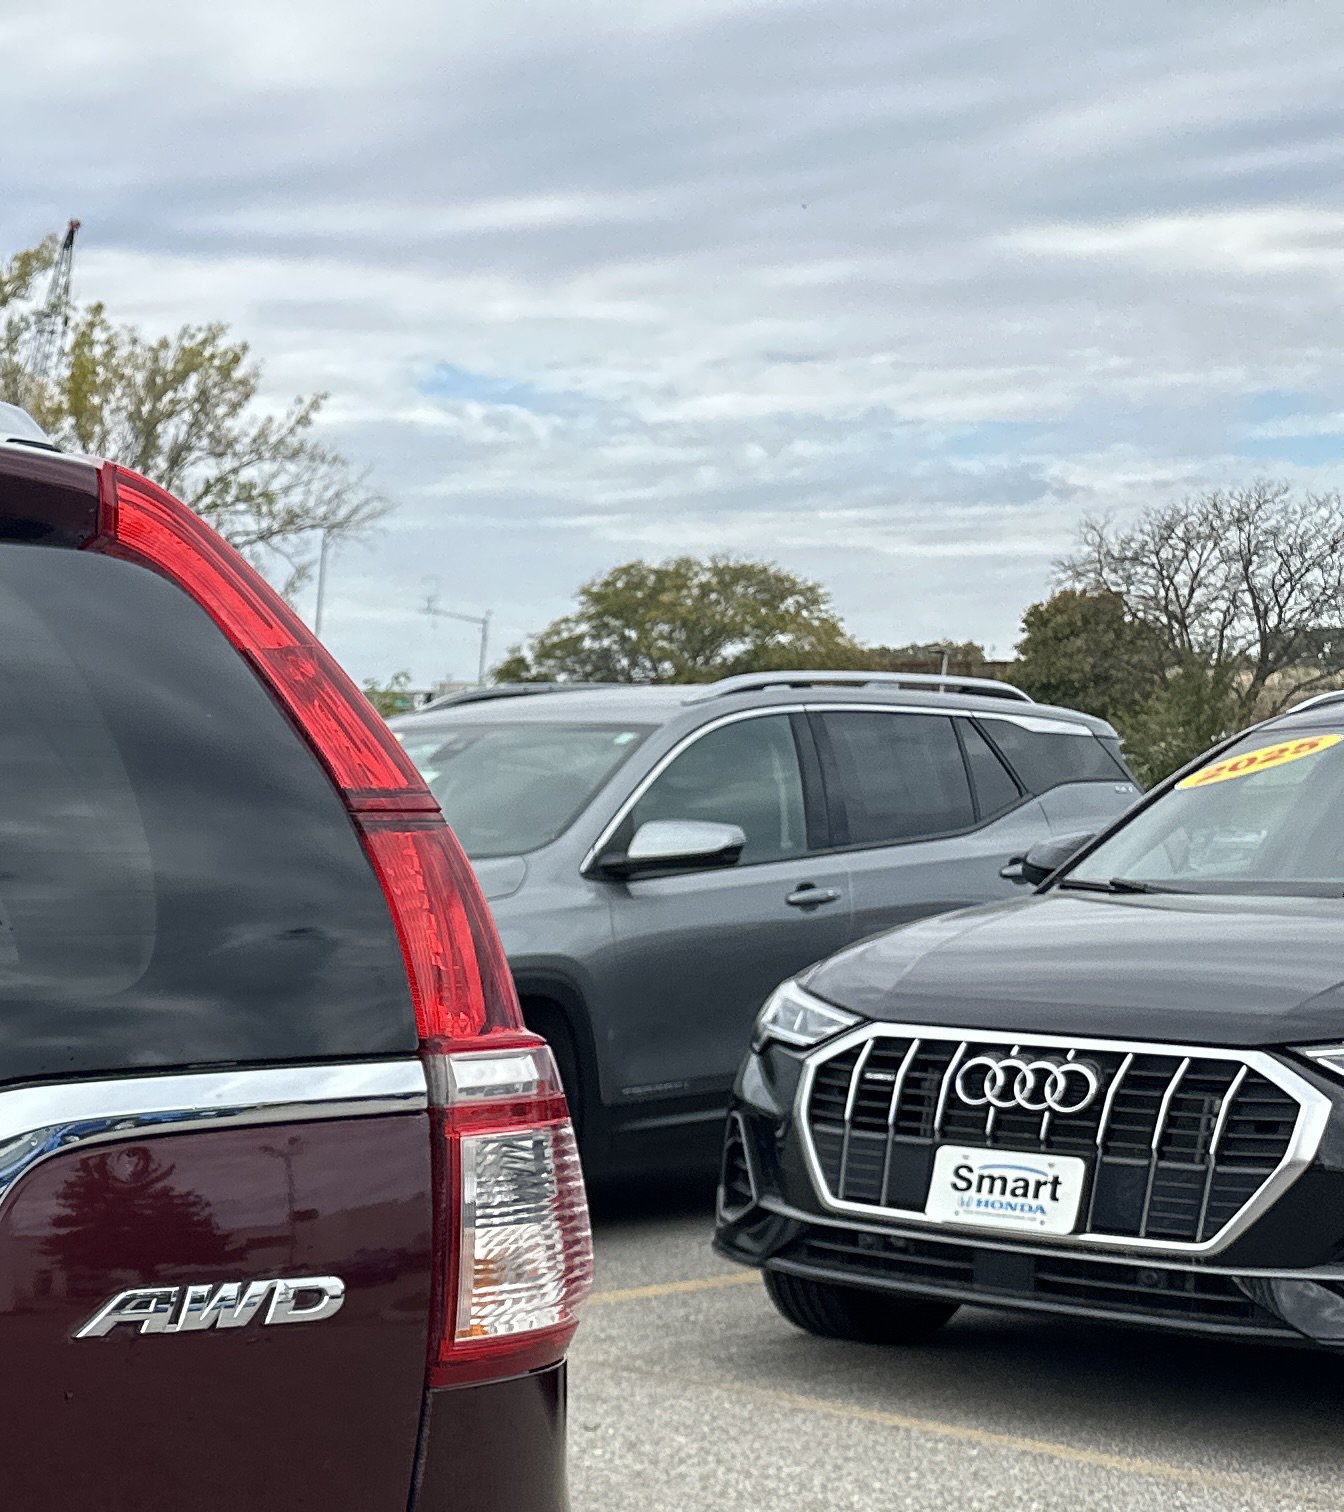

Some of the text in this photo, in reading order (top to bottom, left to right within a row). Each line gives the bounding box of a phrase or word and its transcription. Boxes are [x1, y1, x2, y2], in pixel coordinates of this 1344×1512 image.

[950, 1163, 1062, 1202] Smart
[975, 1198, 1047, 1216] HONDA
[74, 1276, 345, 1338] AWD
